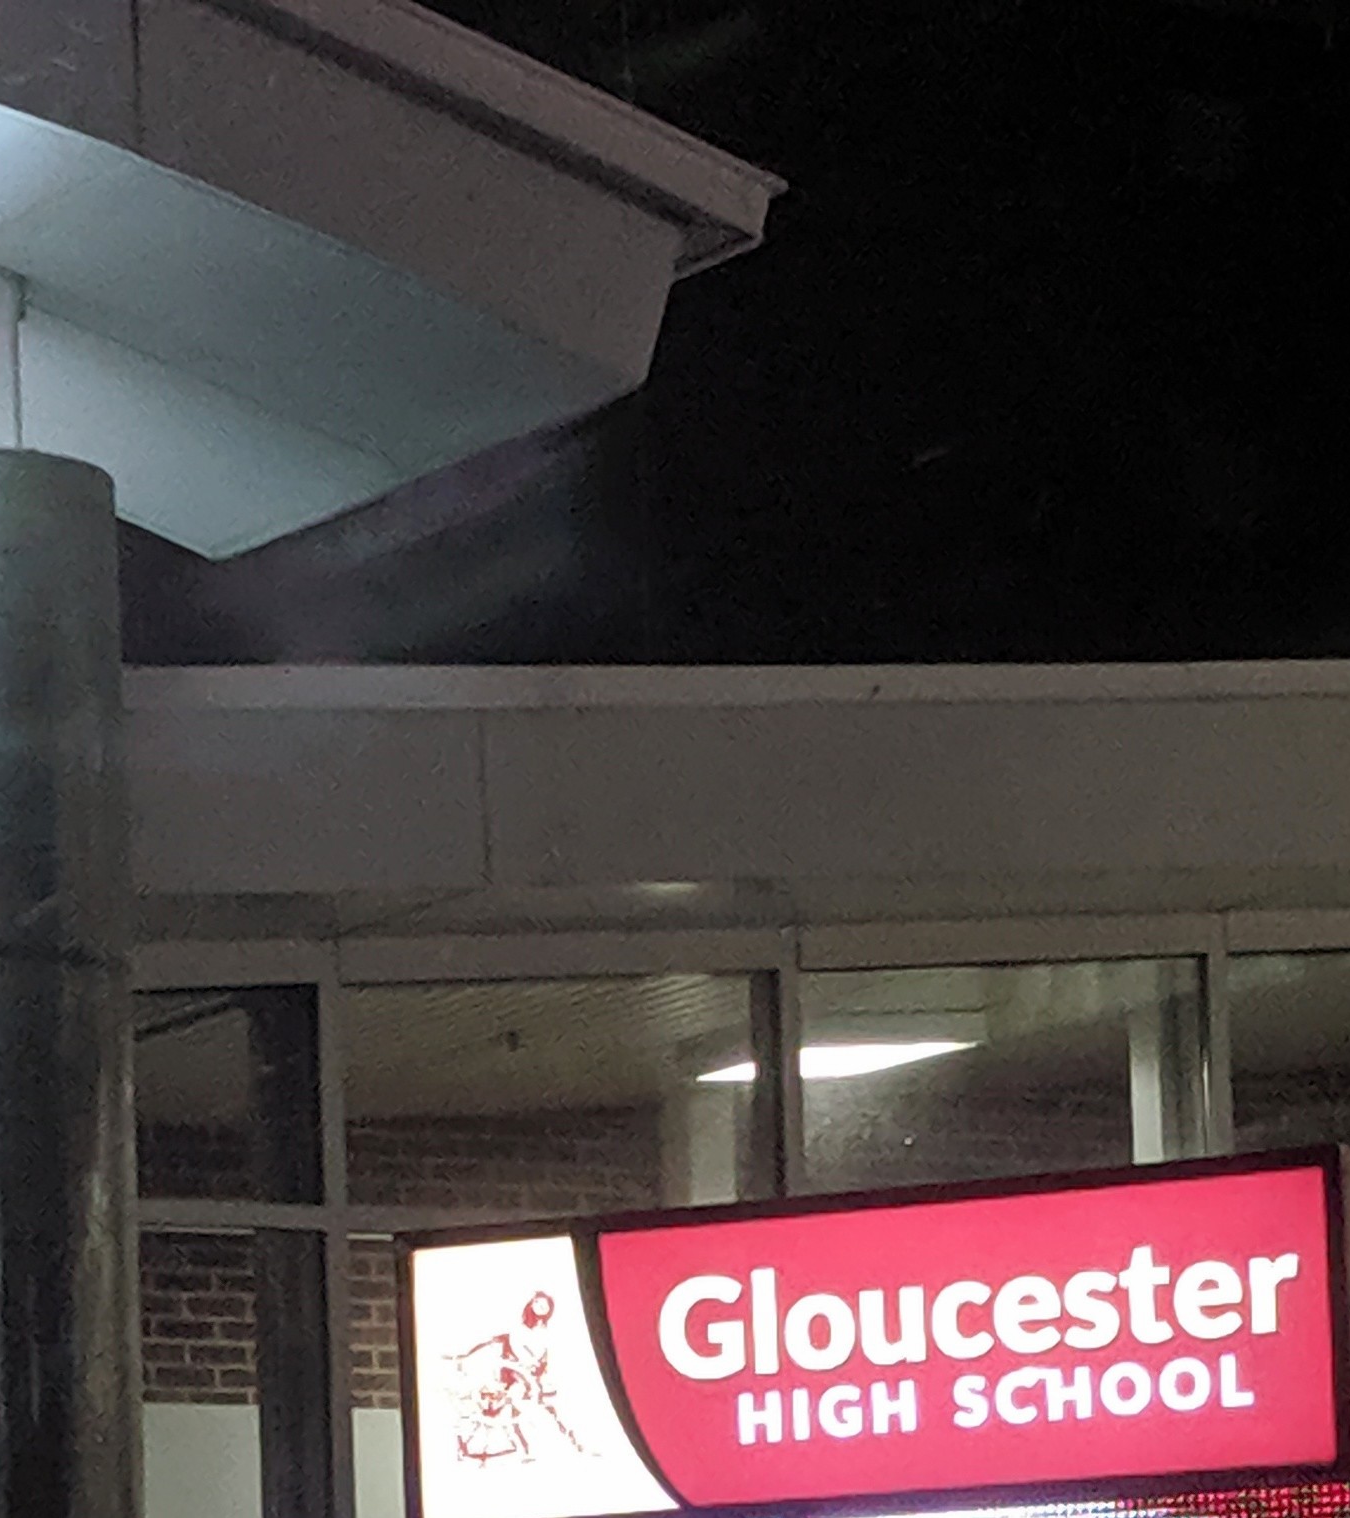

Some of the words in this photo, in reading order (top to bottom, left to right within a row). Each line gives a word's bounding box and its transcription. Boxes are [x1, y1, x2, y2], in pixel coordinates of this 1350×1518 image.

[656, 1243, 1301, 1381] Gloucester
[735, 1377, 920, 1447] HIGH
[951, 1351, 1257, 1430] SCHOOL
